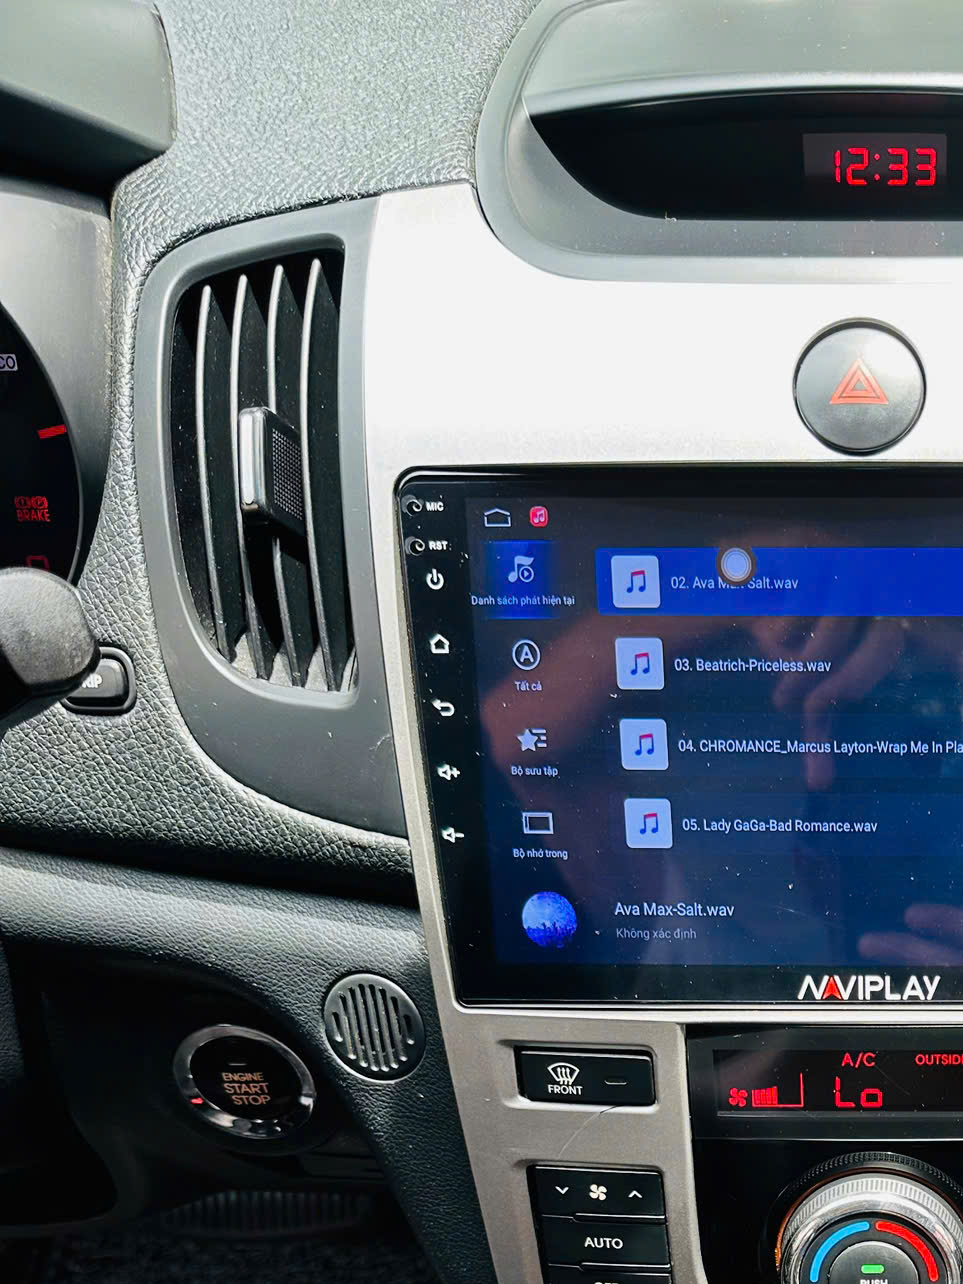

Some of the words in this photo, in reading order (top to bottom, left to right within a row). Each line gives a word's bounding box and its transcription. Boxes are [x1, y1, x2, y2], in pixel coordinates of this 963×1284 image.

[834, 147, 937, 186] 12:33
[425, 501, 444, 512] MIC
[16, 509, 50, 521] BRAKE
[428, 540, 449, 551] RST
[671, 576, 689, 589] 02.
[692, 576, 715, 589] Ava
[471, 594, 495, 606] Danh
[497, 595, 519, 606] sách
[520, 595, 541, 607] phát
[542, 595, 562, 607] hiện
[563, 595, 576, 607] tại
[674, 658, 693, 672] 03.
[696, 658, 832, 672] Beatrich-Priceless.wav
[514, 680, 529, 692] Tất
[531, 680, 543, 692] cả
[678, 739, 696, 753] 04.
[699, 739, 831, 754] CHROMANCE_Marcus
[833, 740, 908, 756] Layton-Wrap
[910, 741, 929, 753] Me
[932, 741, 944, 753] In
[511, 765, 523, 777] Bộ
[682, 818, 700, 832] 05.
[703, 818, 731, 834] Lady
[733, 819, 792, 832] GaGa-Bad
[795, 819, 878, 833] Romance.wav
[513, 847, 524, 860] Bộ
[545, 849, 569, 861] trong
[614, 902, 641, 916] Ava
[643, 902, 735, 917] Max-Salt.wav
[616, 927, 650, 941] Không
[652, 927, 672, 939] xác
[673, 927, 697, 940] định
[797, 974, 941, 1001] NAVIPLAY
[841, 1053, 876, 1068] A/C
[221, 1071, 264, 1082] ENGINE
[223, 1082, 269, 1094] START
[547, 1084, 584, 1096] FRONT
[233, 1094, 272, 1106] STOP
[584, 1236, 624, 1250] AUTO
